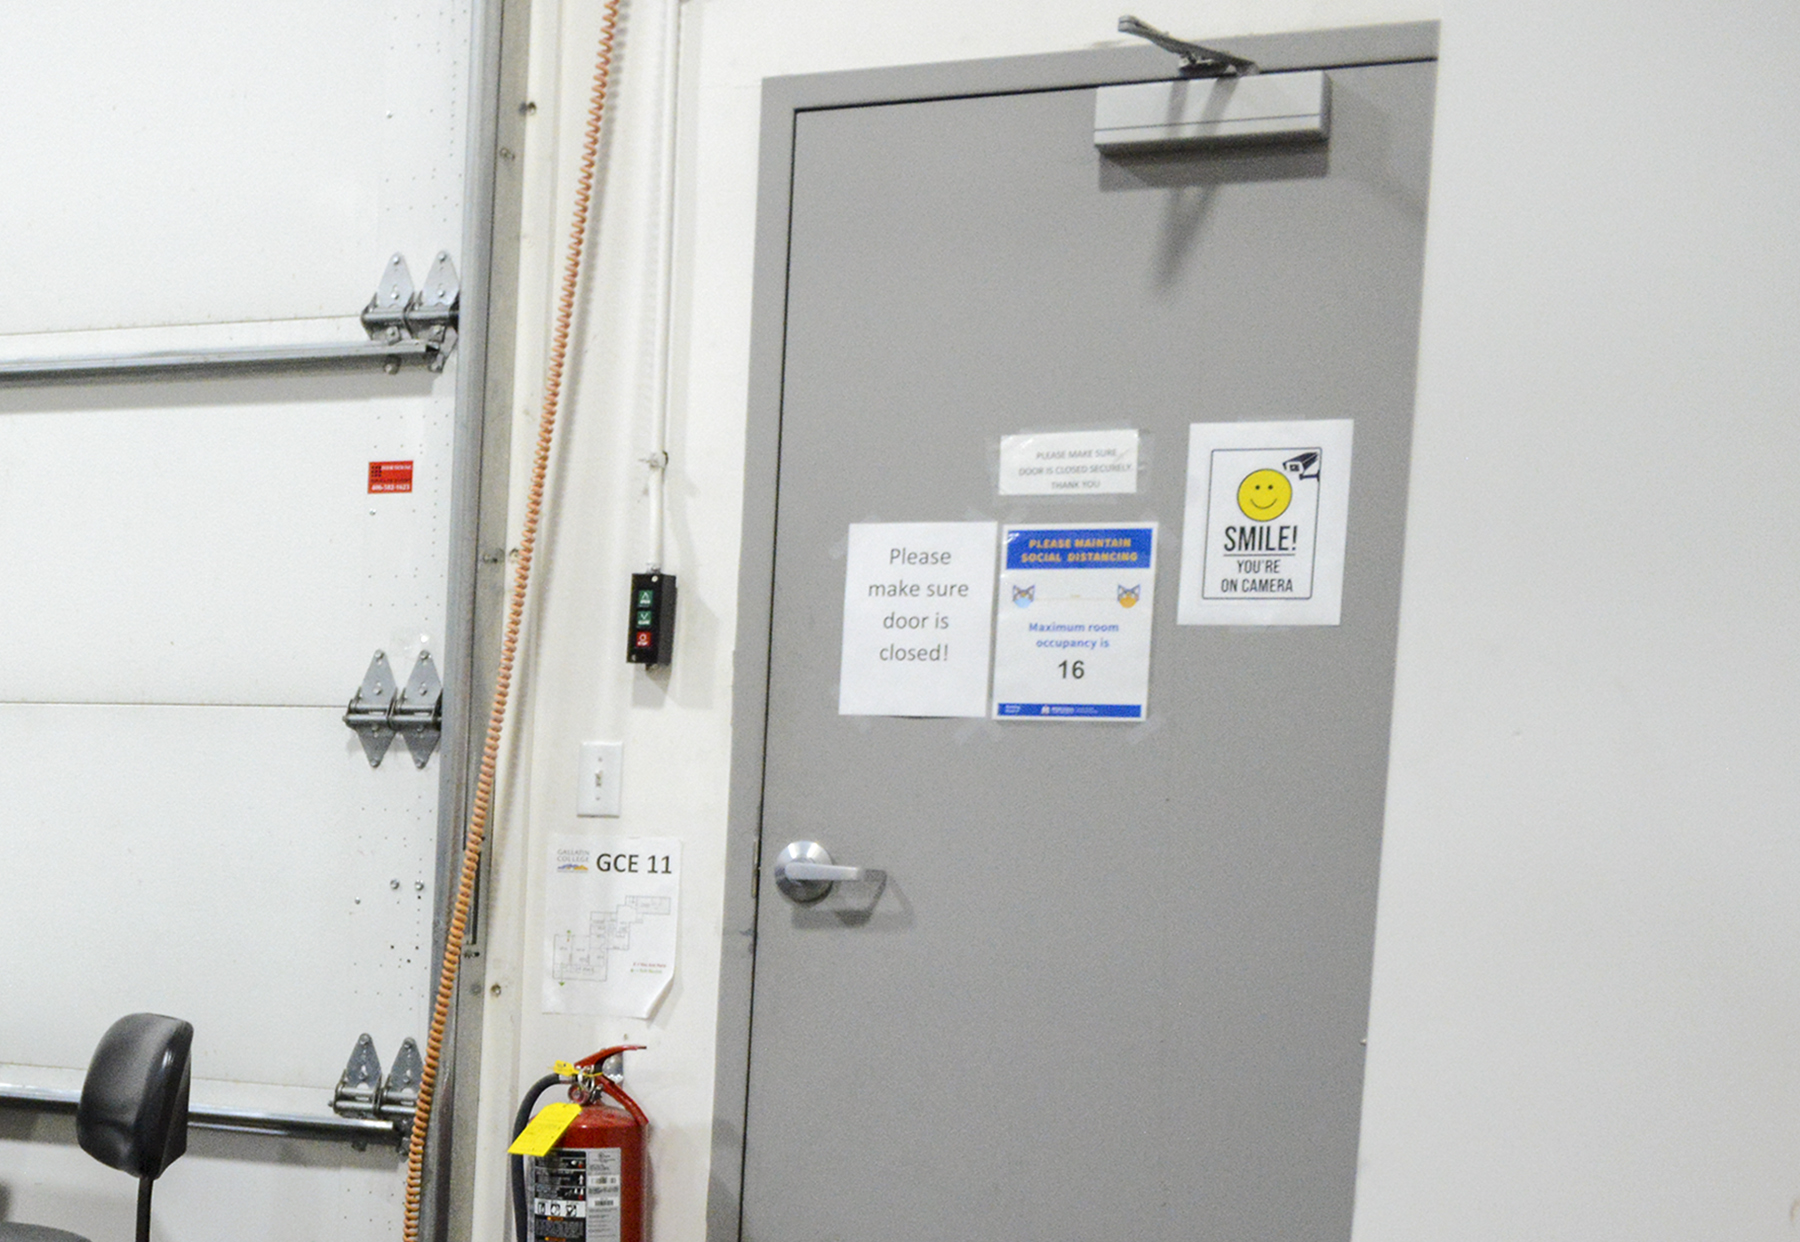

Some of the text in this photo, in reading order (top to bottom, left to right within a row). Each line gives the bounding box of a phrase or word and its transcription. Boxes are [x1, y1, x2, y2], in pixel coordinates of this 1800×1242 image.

[1036, 448, 1117, 460] PLEASE MAKE SURE
[1018, 467, 1043, 476] DOOR
[1046, 467, 1053, 475] IS
[1055, 465, 1087, 475] CLOSED
[1051, 480, 1101, 489] THANK YOU
[1028, 537, 1132, 549] PLEASE MAINTAIN
[1223, 525, 1297, 552] SMILE!
[889, 547, 952, 565] Please
[1021, 551, 1138, 563] SOCIAL DISTANCING
[1236, 559, 1281, 574] YOU'RE
[868, 579, 969, 597] make sure
[1220, 578, 1293, 593] ON CAMERA
[882, 611, 950, 630] door is
[1028, 622, 1119, 632] Maximum room
[1036, 637, 1110, 650] occupancy is
[879, 643, 948, 661] closed!
[1058, 659, 1085, 679] 16
[596, 853, 672, 874] GCE 11
